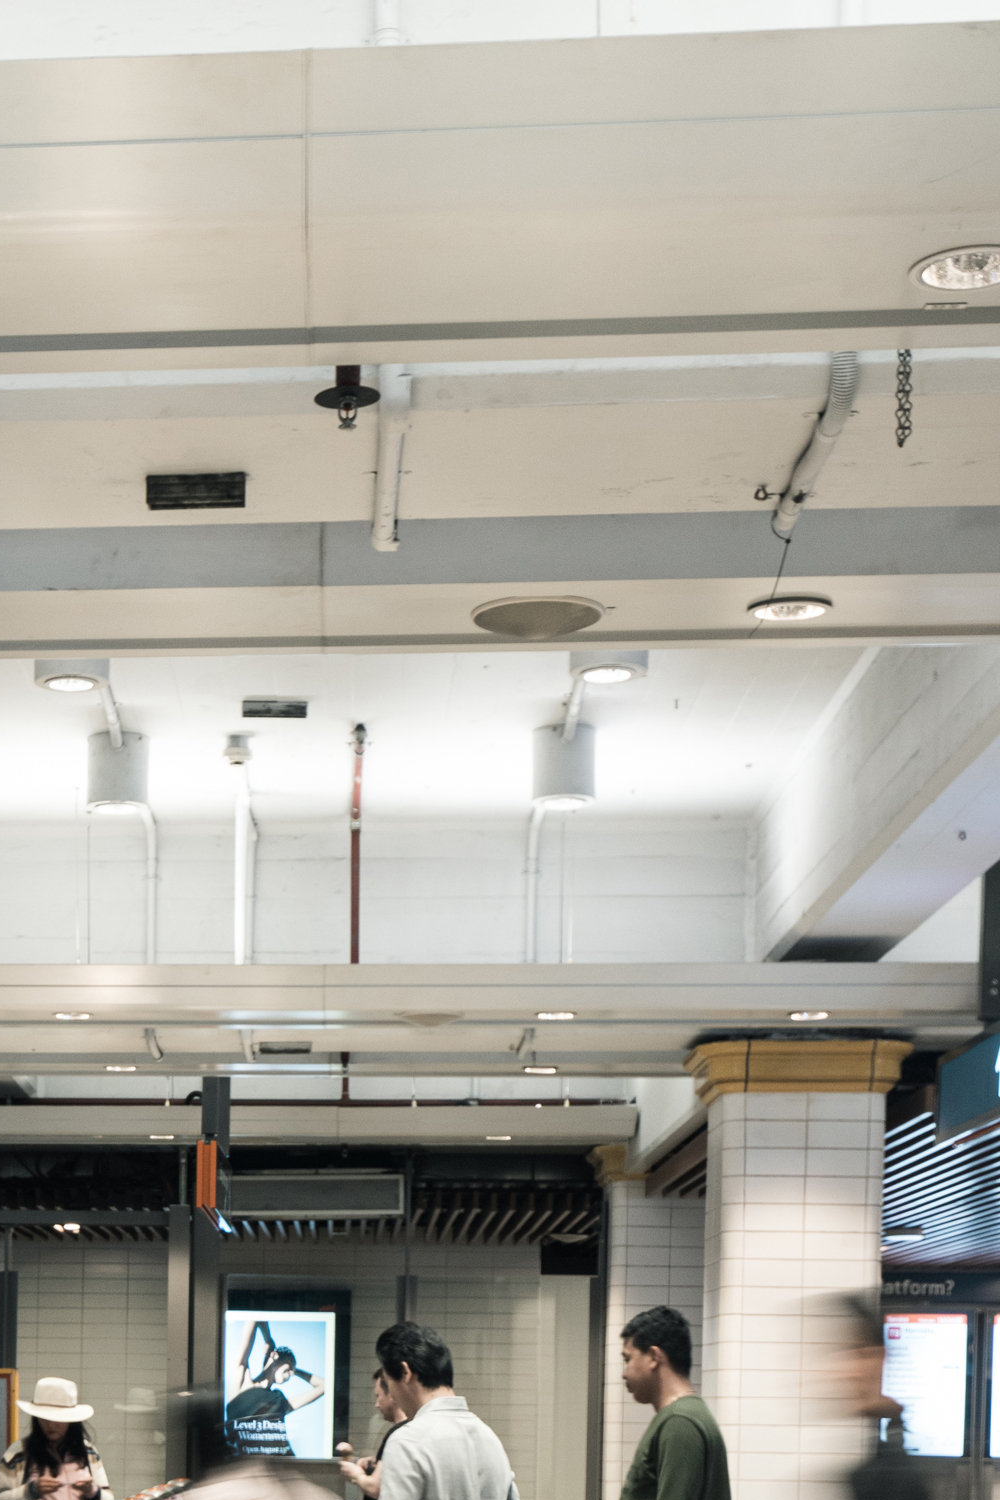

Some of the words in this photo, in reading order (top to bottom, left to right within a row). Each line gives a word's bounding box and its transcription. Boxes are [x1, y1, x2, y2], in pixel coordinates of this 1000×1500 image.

[881, 1279, 956, 1296] atform?
[233, 1420, 257, 1431] Level
[238, 1431, 295, 1441] Womenswe
